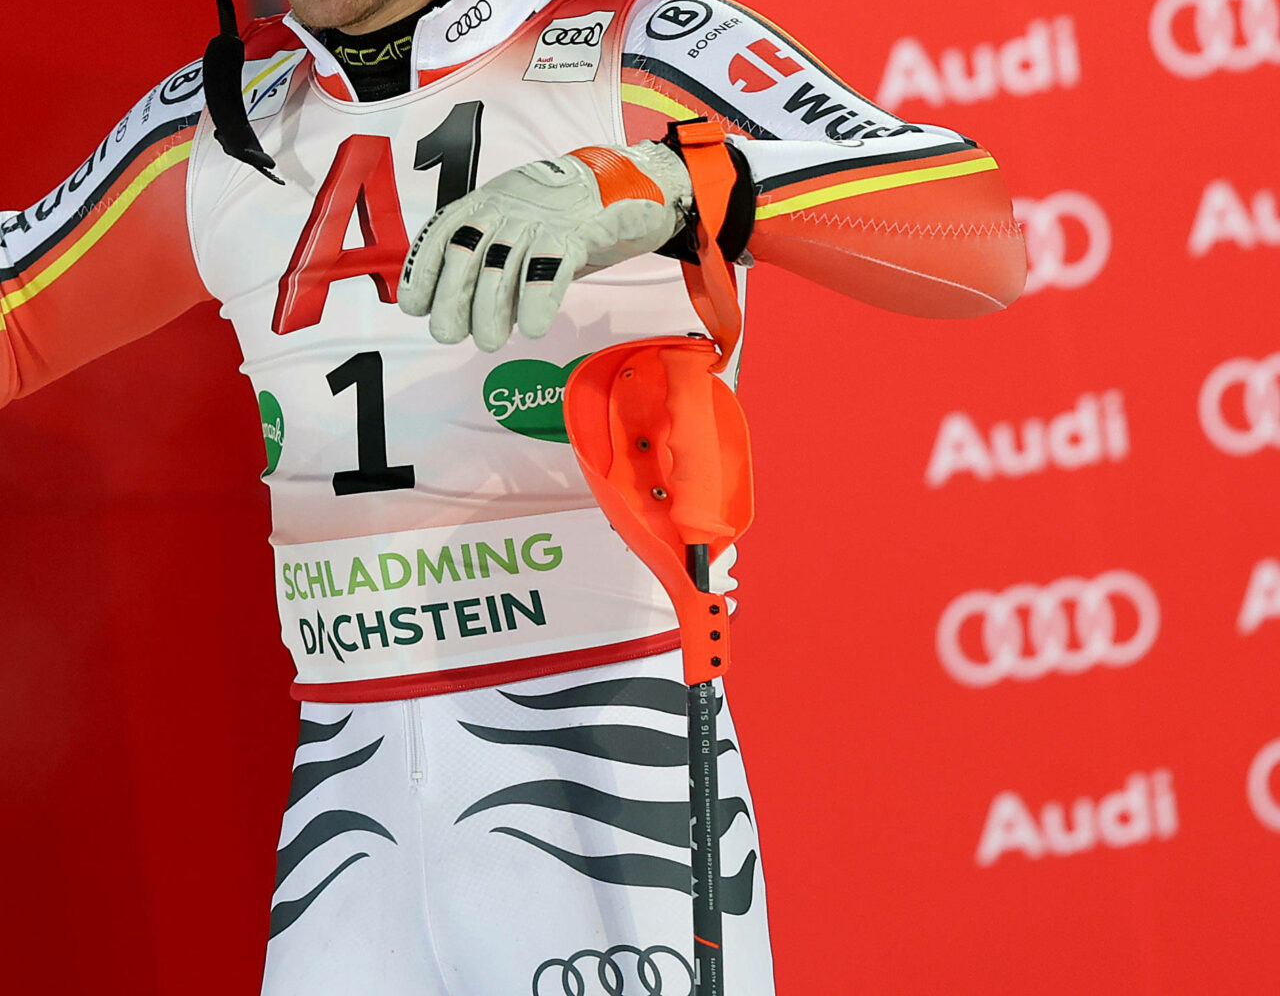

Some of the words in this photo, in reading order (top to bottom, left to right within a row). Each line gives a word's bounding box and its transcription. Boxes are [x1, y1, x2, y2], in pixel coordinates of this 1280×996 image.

[687, 17, 744, 59] BOGNER
[558, 61, 579, 69] World
[876, 14, 1082, 112] Audi
[325, 350, 416, 496] 1
[488, 384, 566, 421] Steier
[923, 387, 1131, 491] Audi
[282, 532, 564, 601] SCHLADMING
[298, 589, 548, 664] DACHSTEIN
[699, 682, 708, 704] PRO
[700, 708, 709, 721] SL
[701, 724, 709, 735] 16
[701, 739, 711, 754] RD
[974, 766, 1180, 868] Audi
